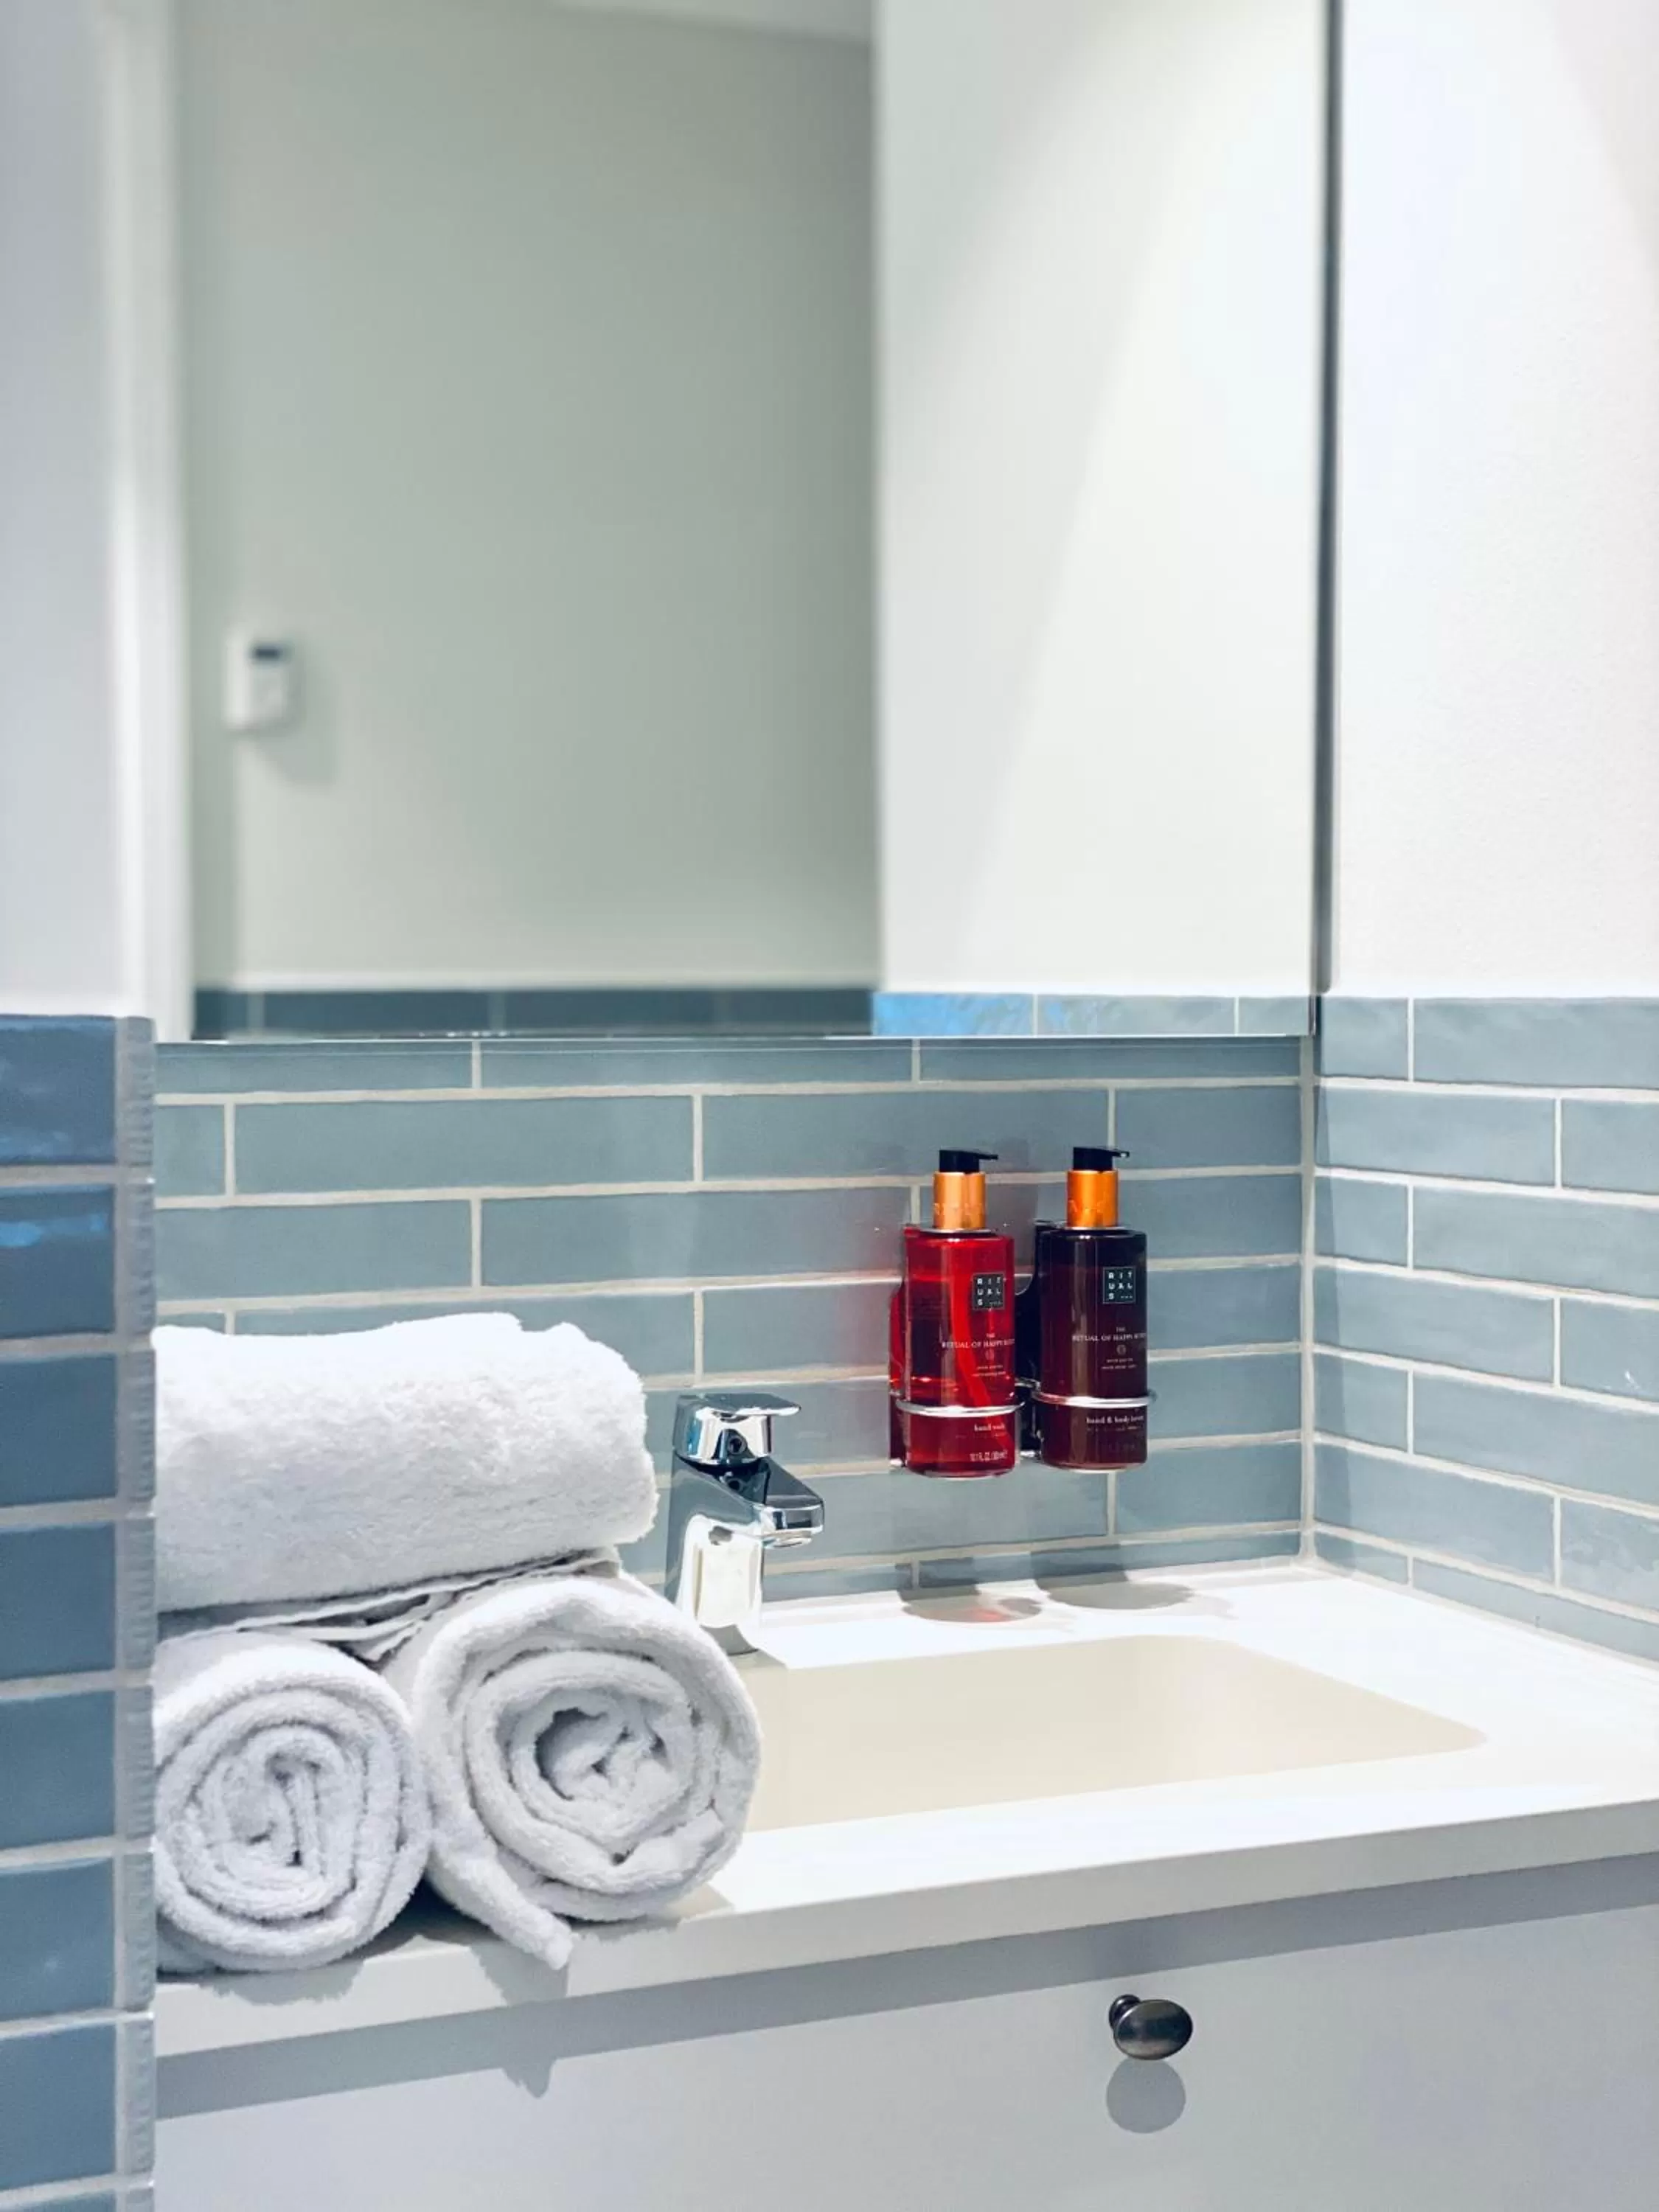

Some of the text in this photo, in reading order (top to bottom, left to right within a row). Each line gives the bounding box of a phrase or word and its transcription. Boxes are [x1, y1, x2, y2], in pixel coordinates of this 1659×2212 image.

[942, 1340, 970, 1349] RITUAL
[970, 1340, 982, 1349] OF
[1086, 1416, 1105, 1425] hand
